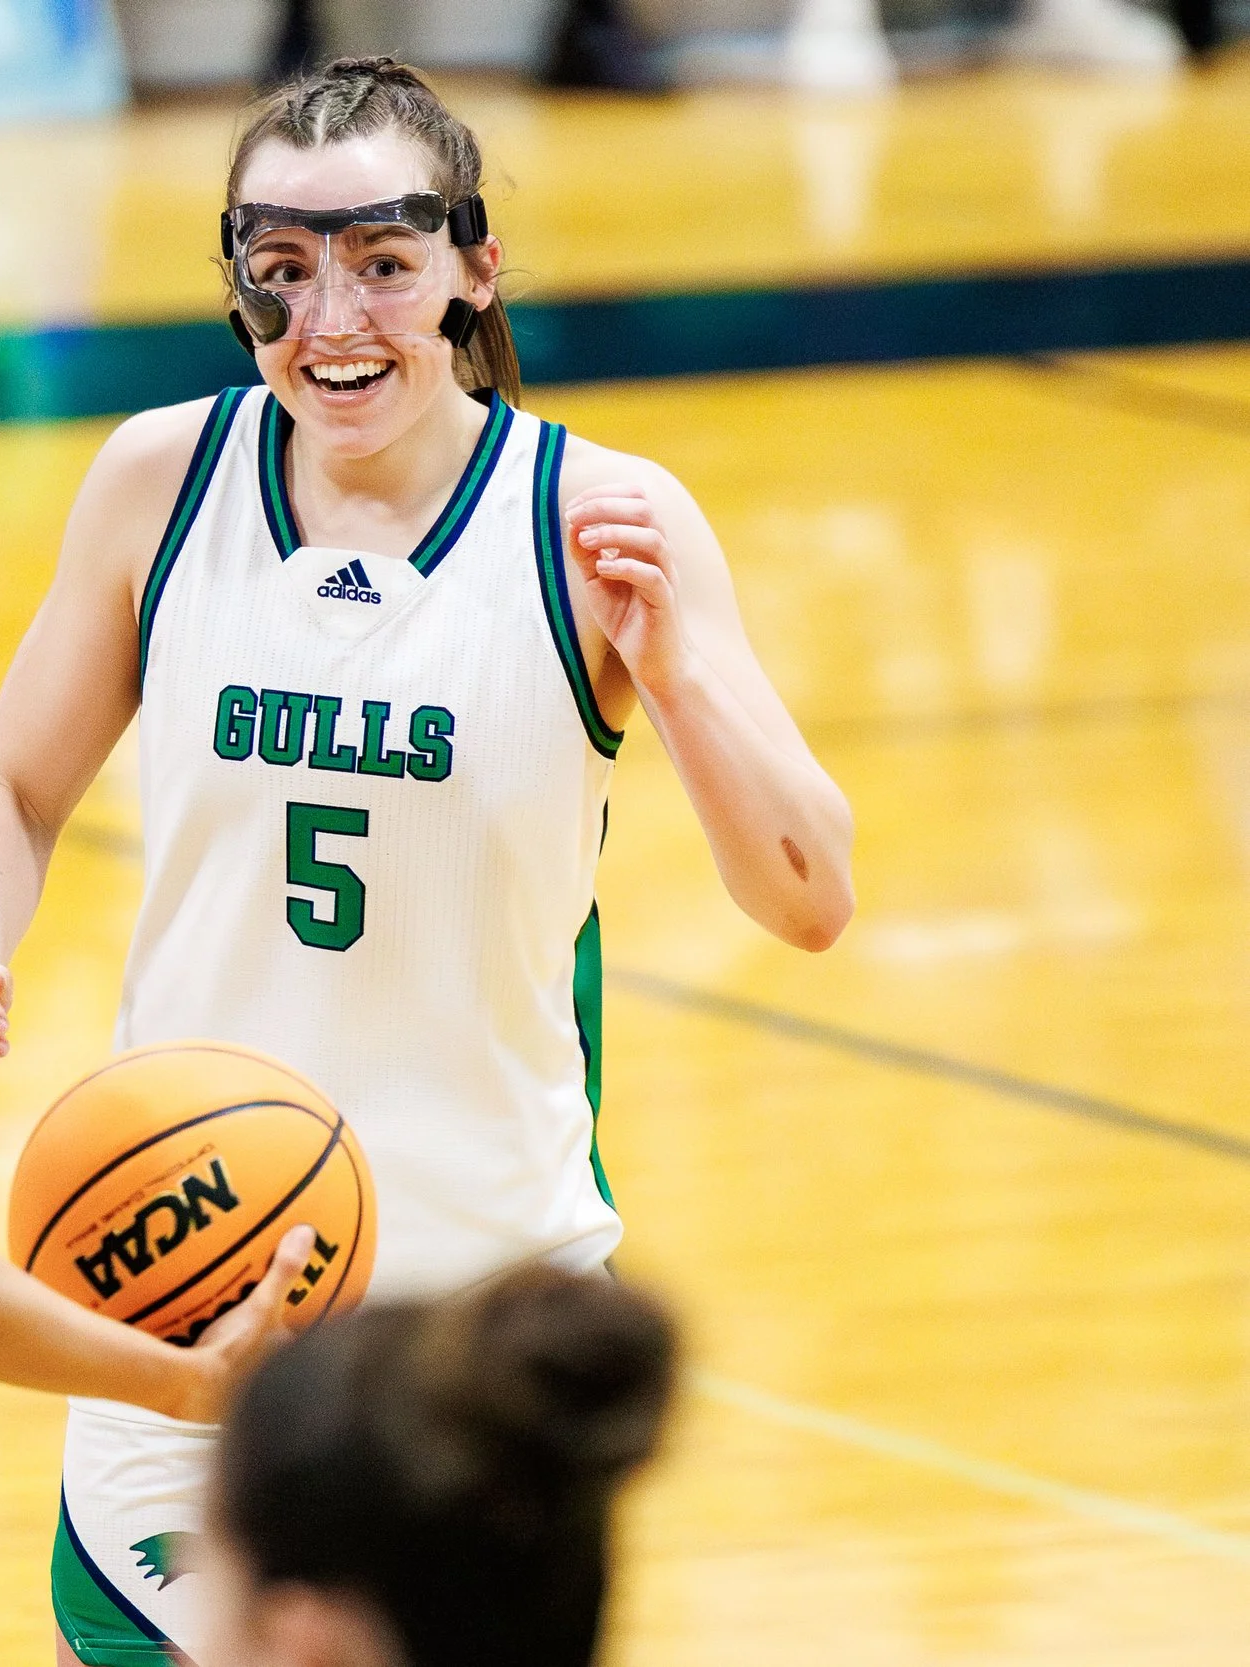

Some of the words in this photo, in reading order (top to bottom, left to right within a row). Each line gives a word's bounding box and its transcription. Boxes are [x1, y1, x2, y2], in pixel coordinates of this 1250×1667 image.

[316, 583, 382, 605] adidas
[213, 684, 455, 782] GULLS
[286, 801, 370, 952] 5
[73, 1156, 242, 1301] NCAA
